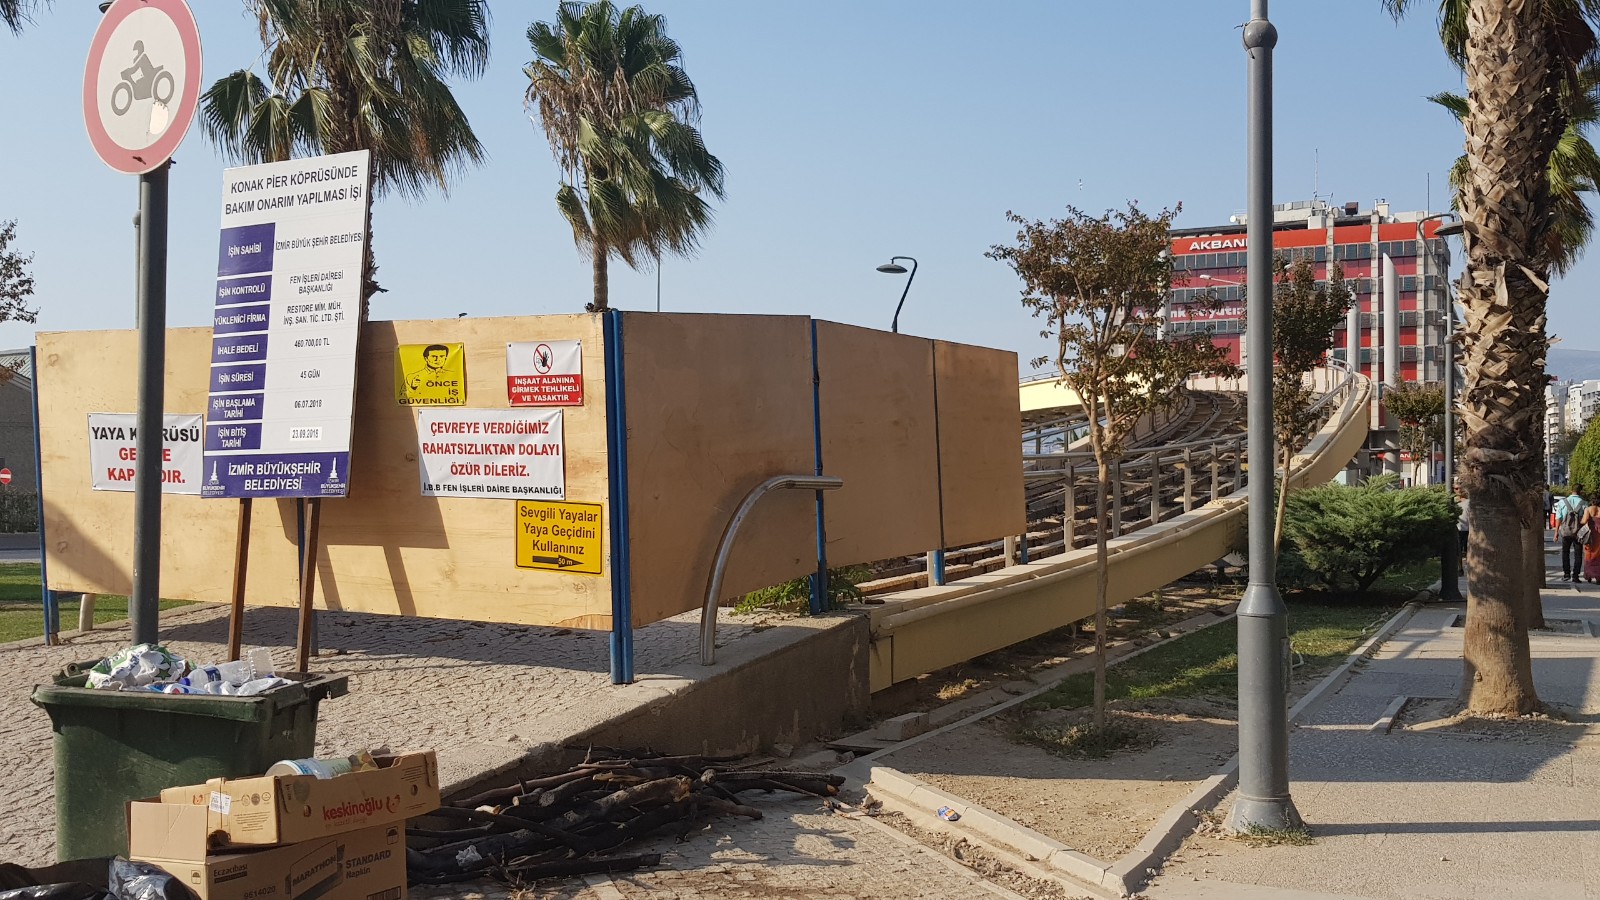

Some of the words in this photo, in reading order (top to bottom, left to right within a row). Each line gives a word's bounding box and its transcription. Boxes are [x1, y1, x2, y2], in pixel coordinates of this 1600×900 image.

[231, 179, 264, 194] KONAK
[266, 174, 288, 190] PİER
[290, 166, 358, 186] KÖPRÜSÜNDE
[225, 201, 255, 215] BAKIM
[257, 197, 294, 211] ONARIM
[296, 188, 348, 206] YAPILMASI
[349, 184, 362, 201] İŞİ
[275, 239, 290, 251] İZMİR
[291, 237, 311, 250] BÜYÜK
[311, 235, 329, 248] ŞEHİR
[330, 231, 364, 244] BELEDİYESİ
[1189, 239, 1248, 251] AKBAN
[228, 245, 240, 258] İŞİN
[241, 242, 262, 255] SAHİBİ
[290, 276, 302, 284] FEN
[302, 273, 320, 284] İŞLERİ
[320, 270, 344, 281] DAİRESİ
[219, 286, 231, 298] İŞİN
[231, 283, 266, 296] KONTROLÜ
[299, 283, 334, 295] BAŞKANLIĞI
[287, 303, 314, 314] RESTORE
[328, 301, 343, 311] MÜH.
[214, 313, 246, 326] YÜKLENİCİ
[246, 312, 266, 323] FİRMA
[295, 316, 309, 325] SAN.
[321, 313, 334, 322] LTD.
[323, 338, 331, 346] TL
[218, 344, 236, 355] İHALE
[236, 343, 259, 354] BEDELİ
[218, 373, 230, 384] İŞİN
[231, 371, 254, 383] SÜRESİ
[300, 371, 307, 379] 45
[308, 369, 321, 379] GÜN
[426, 380, 459, 388] ÖNCE
[515, 376, 541, 386] İNŞAAT
[542, 376, 575, 385] ALANINA
[448, 388, 459, 396] İŞ
[511, 385, 540, 393] GİRMEK
[541, 384, 580, 393] TEHLİKELİ
[213, 398, 225, 410] İŞİN
[225, 397, 256, 409] BAŞLAMA
[399, 397, 459, 405] GÜVENLİĞİ
[533, 394, 569, 402] YASAKTIR
[224, 408, 243, 418] TARİHİ
[92, 427, 126, 440] YAYA
[129, 425, 200, 442] KRÜSÜ
[218, 427, 230, 438] İŞİN
[230, 427, 247, 437] BİTİŞ
[430, 422, 480, 436] ÇEVREYE
[483, 420, 549, 435] VERDİĞİMİZ
[222, 437, 242, 448] TARİHİ
[119, 447, 171, 462] GEE
[422, 443, 515, 456] RAHATSIZLIKTAN
[518, 443, 560, 456] DOLAYI
[228, 462, 254, 476] İZMİR
[256, 460, 321, 477] BÜYÜKŞEHİR
[450, 461, 481, 476] ÖZÜR
[484, 461, 530, 477] DİLERİZ.
[107, 468, 186, 484] KAPDIR.
[244, 476, 303, 491] BELEDİYESİ
[423, 482, 441, 491] İ.B.B
[443, 484, 458, 492] FEN
[460, 483, 485, 493] İŞLERİ
[486, 484, 510, 493] DAİRE
[512, 485, 562, 495] BAŞKANLIĞI
[520, 506, 556, 522] Sevgili
[558, 508, 598, 524] Yayalar
[523, 522, 548, 538] Yaya
[551, 524, 596, 540] Geçidini
[532, 539, 585, 555] Kullanınız
[558, 557, 566, 565] 50
[322, 797, 383, 820] keskinoğlu
[345, 849, 392, 869] STANDARD
[292, 855, 337, 886] MARATHON
[346, 866, 371, 880] Napkin
